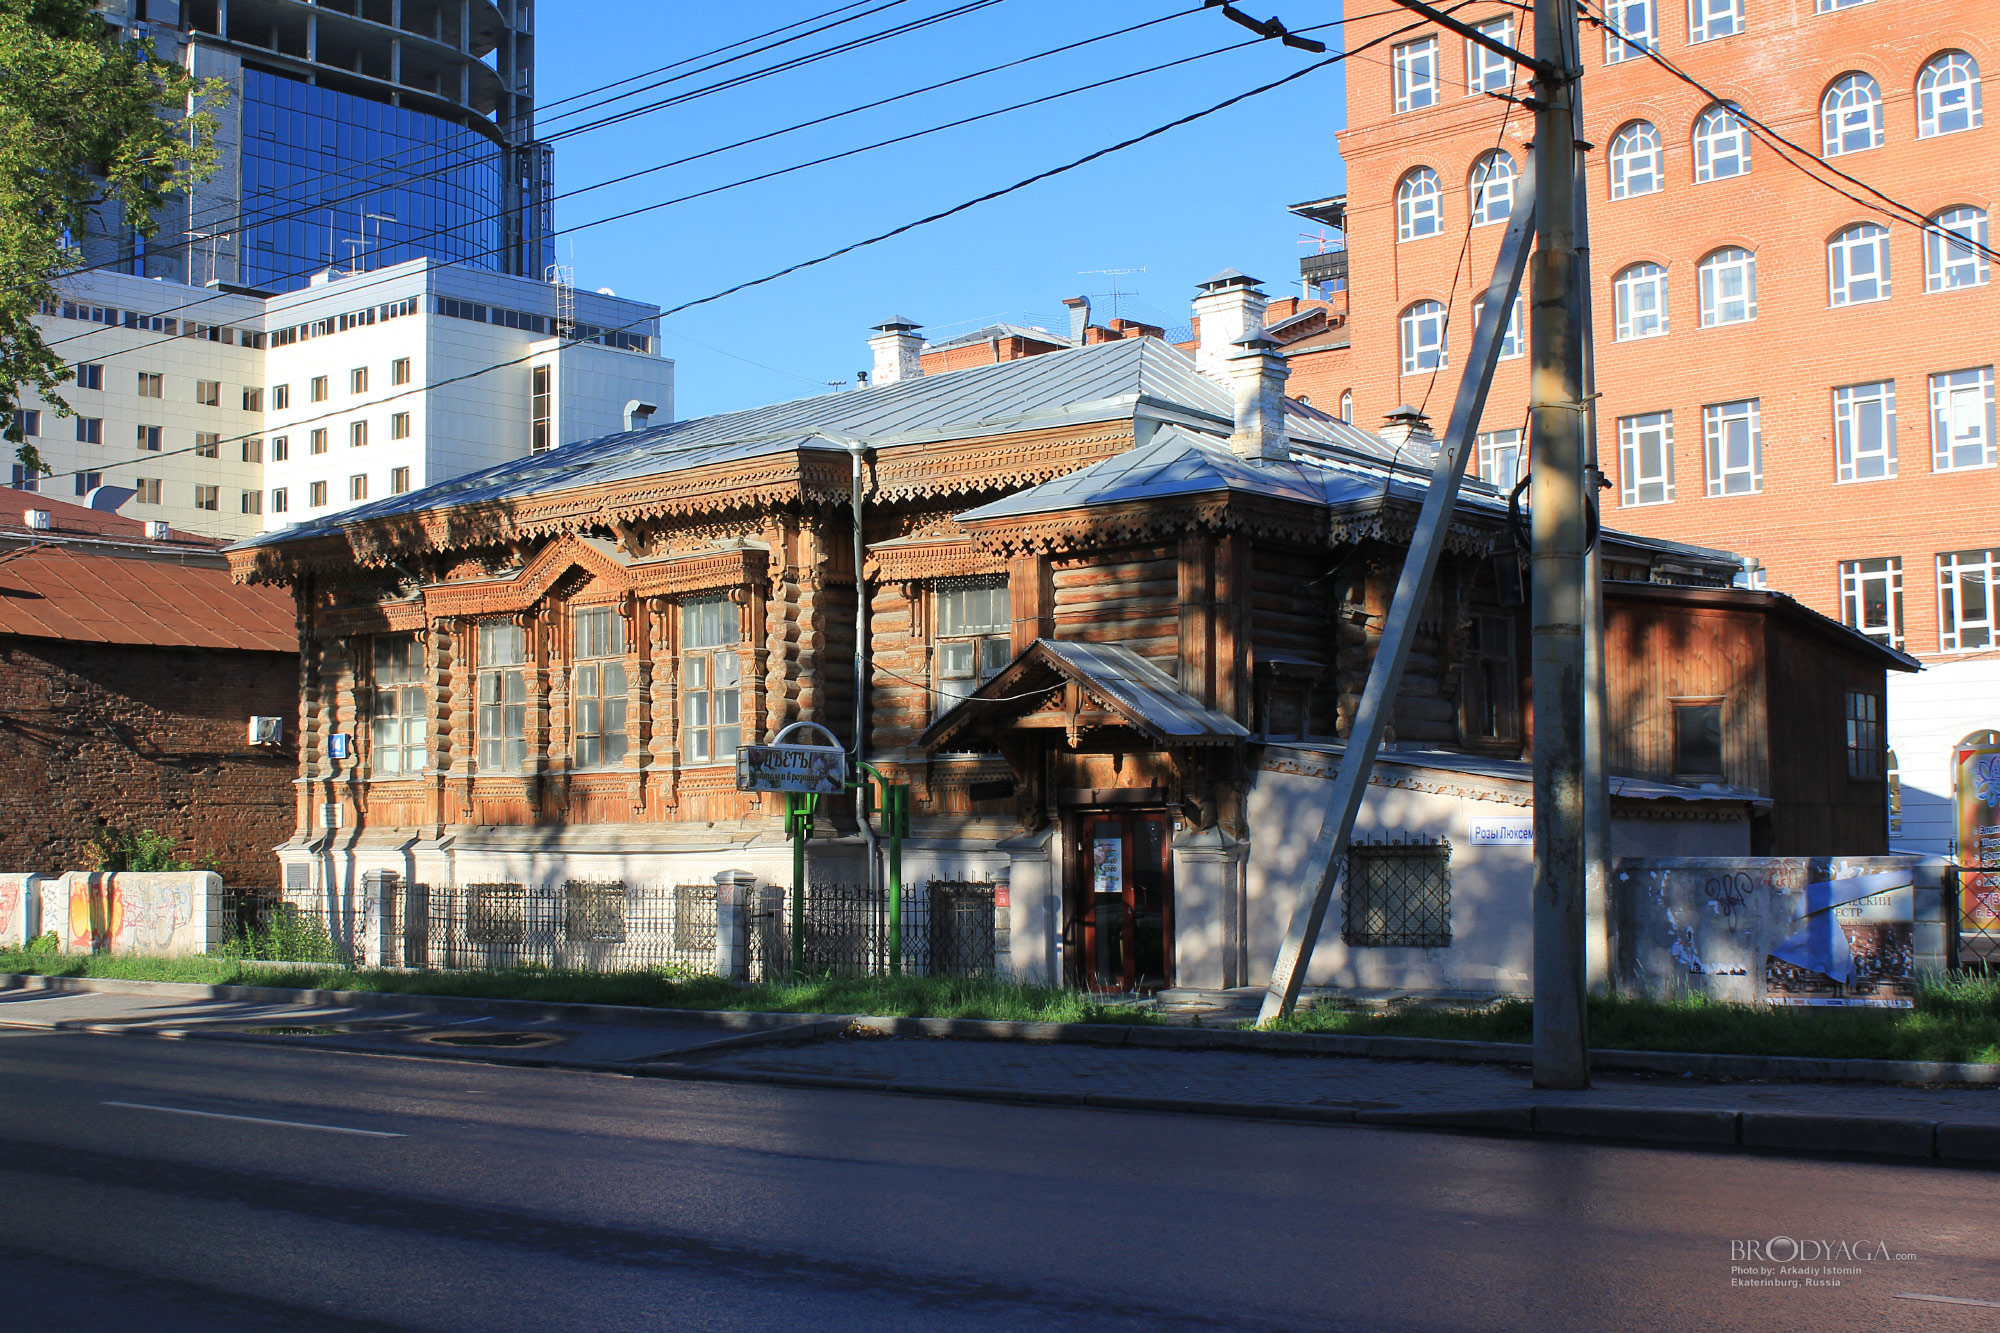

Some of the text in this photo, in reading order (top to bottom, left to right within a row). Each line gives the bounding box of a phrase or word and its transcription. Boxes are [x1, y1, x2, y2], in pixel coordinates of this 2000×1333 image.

[331, 737, 341, 751] 14
[763, 750, 812, 769] ЦВЕТЫ
[1475, 826, 1498, 839] Розы
